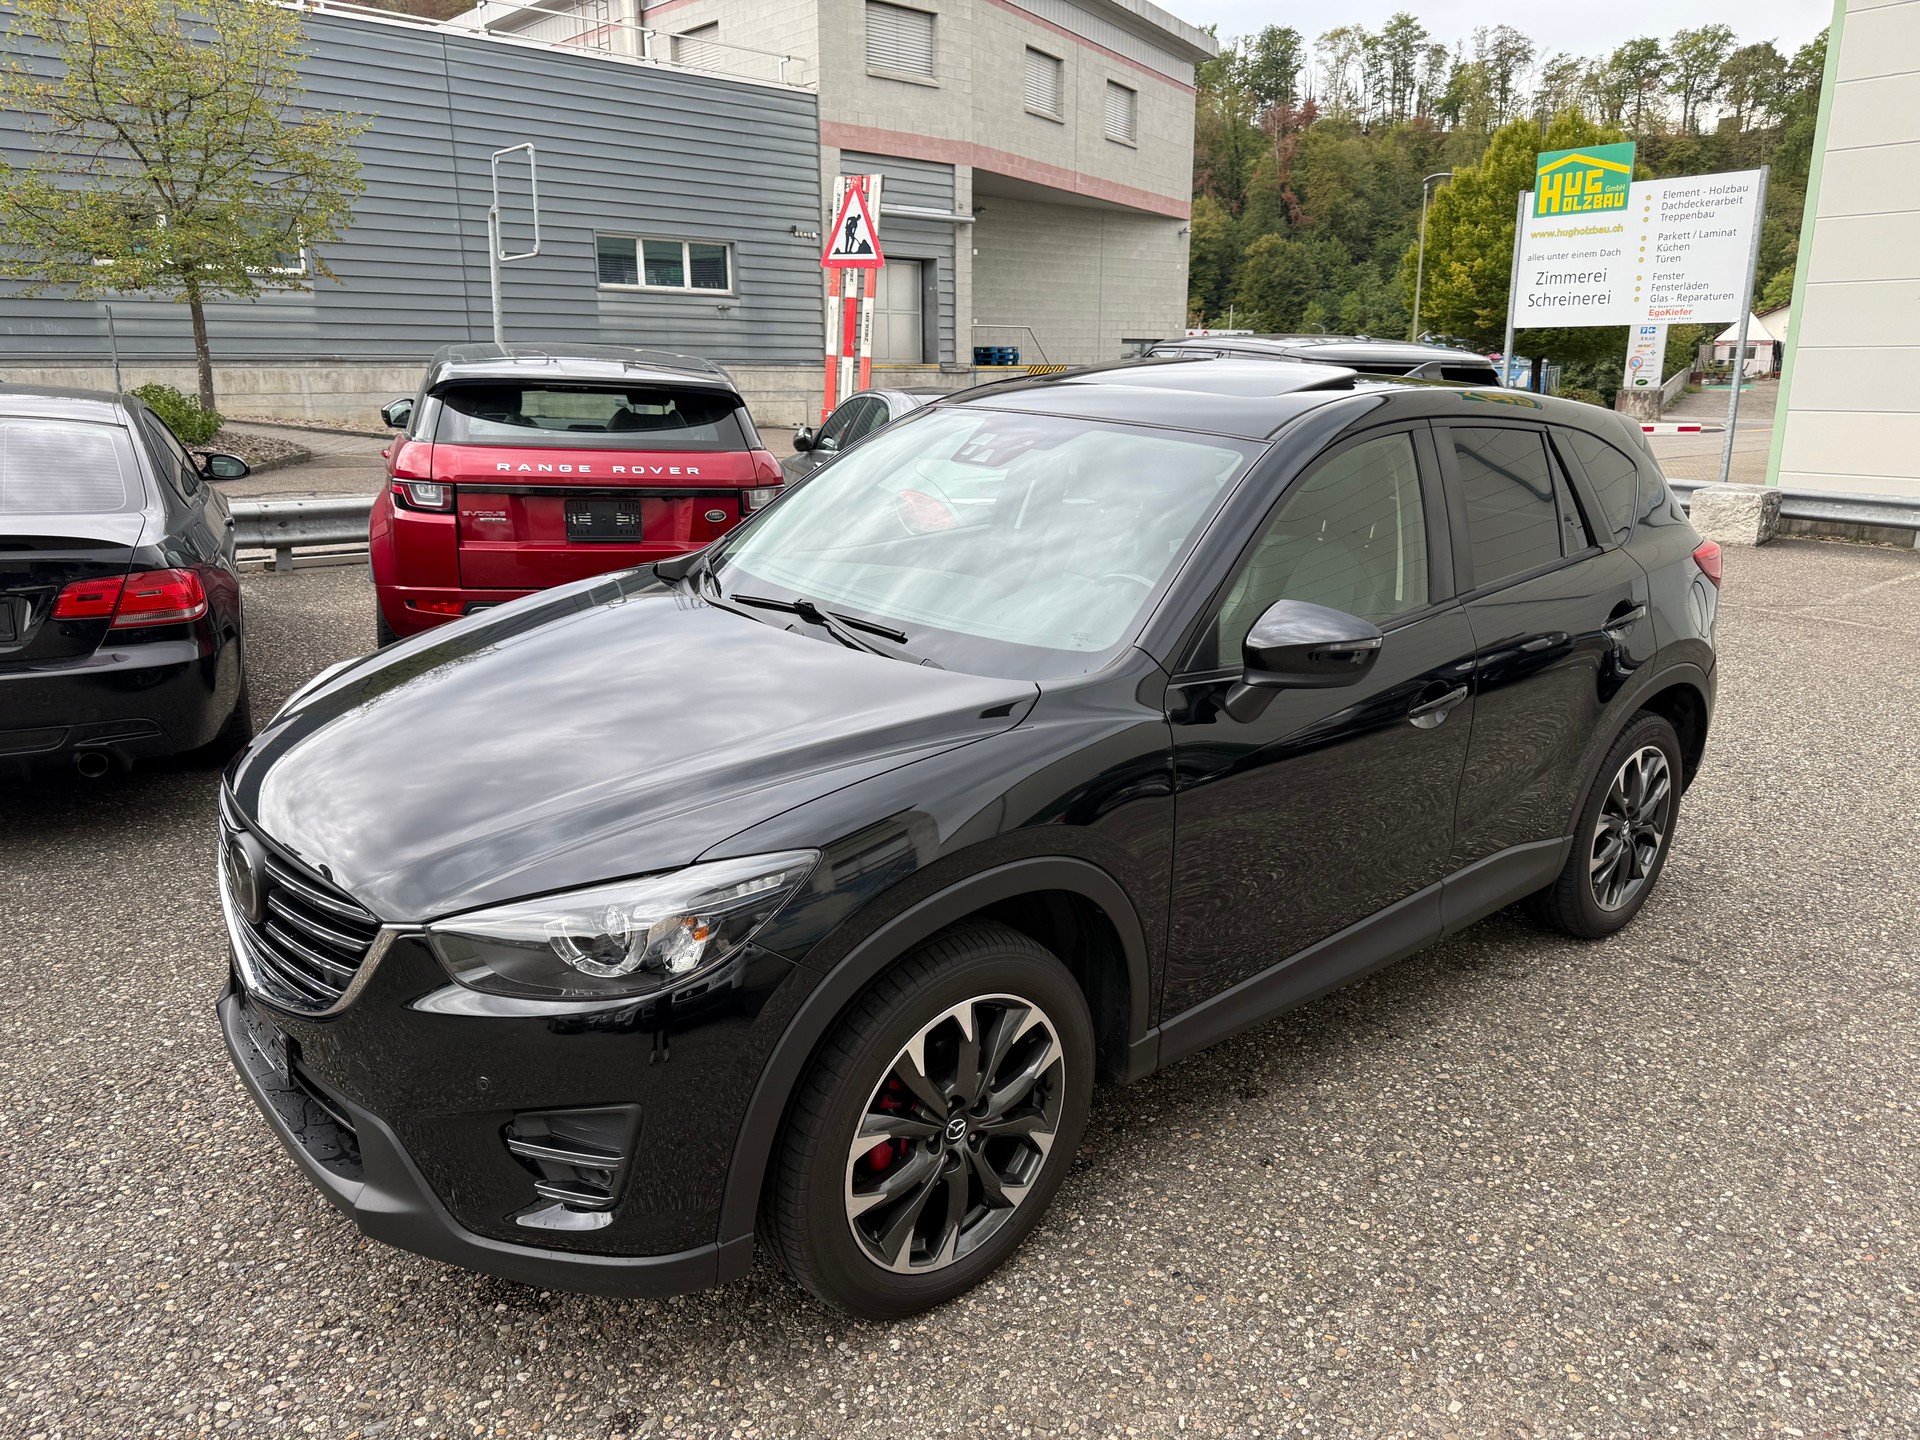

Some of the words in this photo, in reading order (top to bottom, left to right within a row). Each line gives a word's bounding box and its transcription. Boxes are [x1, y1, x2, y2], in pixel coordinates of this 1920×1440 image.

[1605, 184, 1626, 193] GmbH
[1663, 188, 1700, 200] Element
[1708, 184, 1749, 196] Holzbau
[1661, 196, 1743, 211] Dachdeckerarbeit
[1660, 211, 1715, 222] Treppenbau
[1530, 223, 1624, 239] www.hugholzbau.ch
[1657, 231, 1691, 241] Parkett
[1698, 228, 1737, 239] Laminat
[1656, 243, 1690, 253] Küchen
[1527, 253, 1545, 262] alles
[1546, 252, 1569, 261] unter
[1571, 250, 1597, 259] einem
[1599, 248, 1622, 257] Dach
[1656, 255, 1681, 263] Türen
[1535, 267, 1607, 286] Zimmerei
[1652, 272, 1685, 281] Fenster
[1651, 282, 1709, 292] Fensterläden
[1527, 289, 1611, 308] Schreinerei
[1649, 294, 1669, 303] Glas
[1676, 292, 1735, 303] Reparaturen
[1648, 308, 1693, 317] EgoKiefer
[496, 463, 592, 473] RANGE
[612, 465, 701, 475] ROVER
